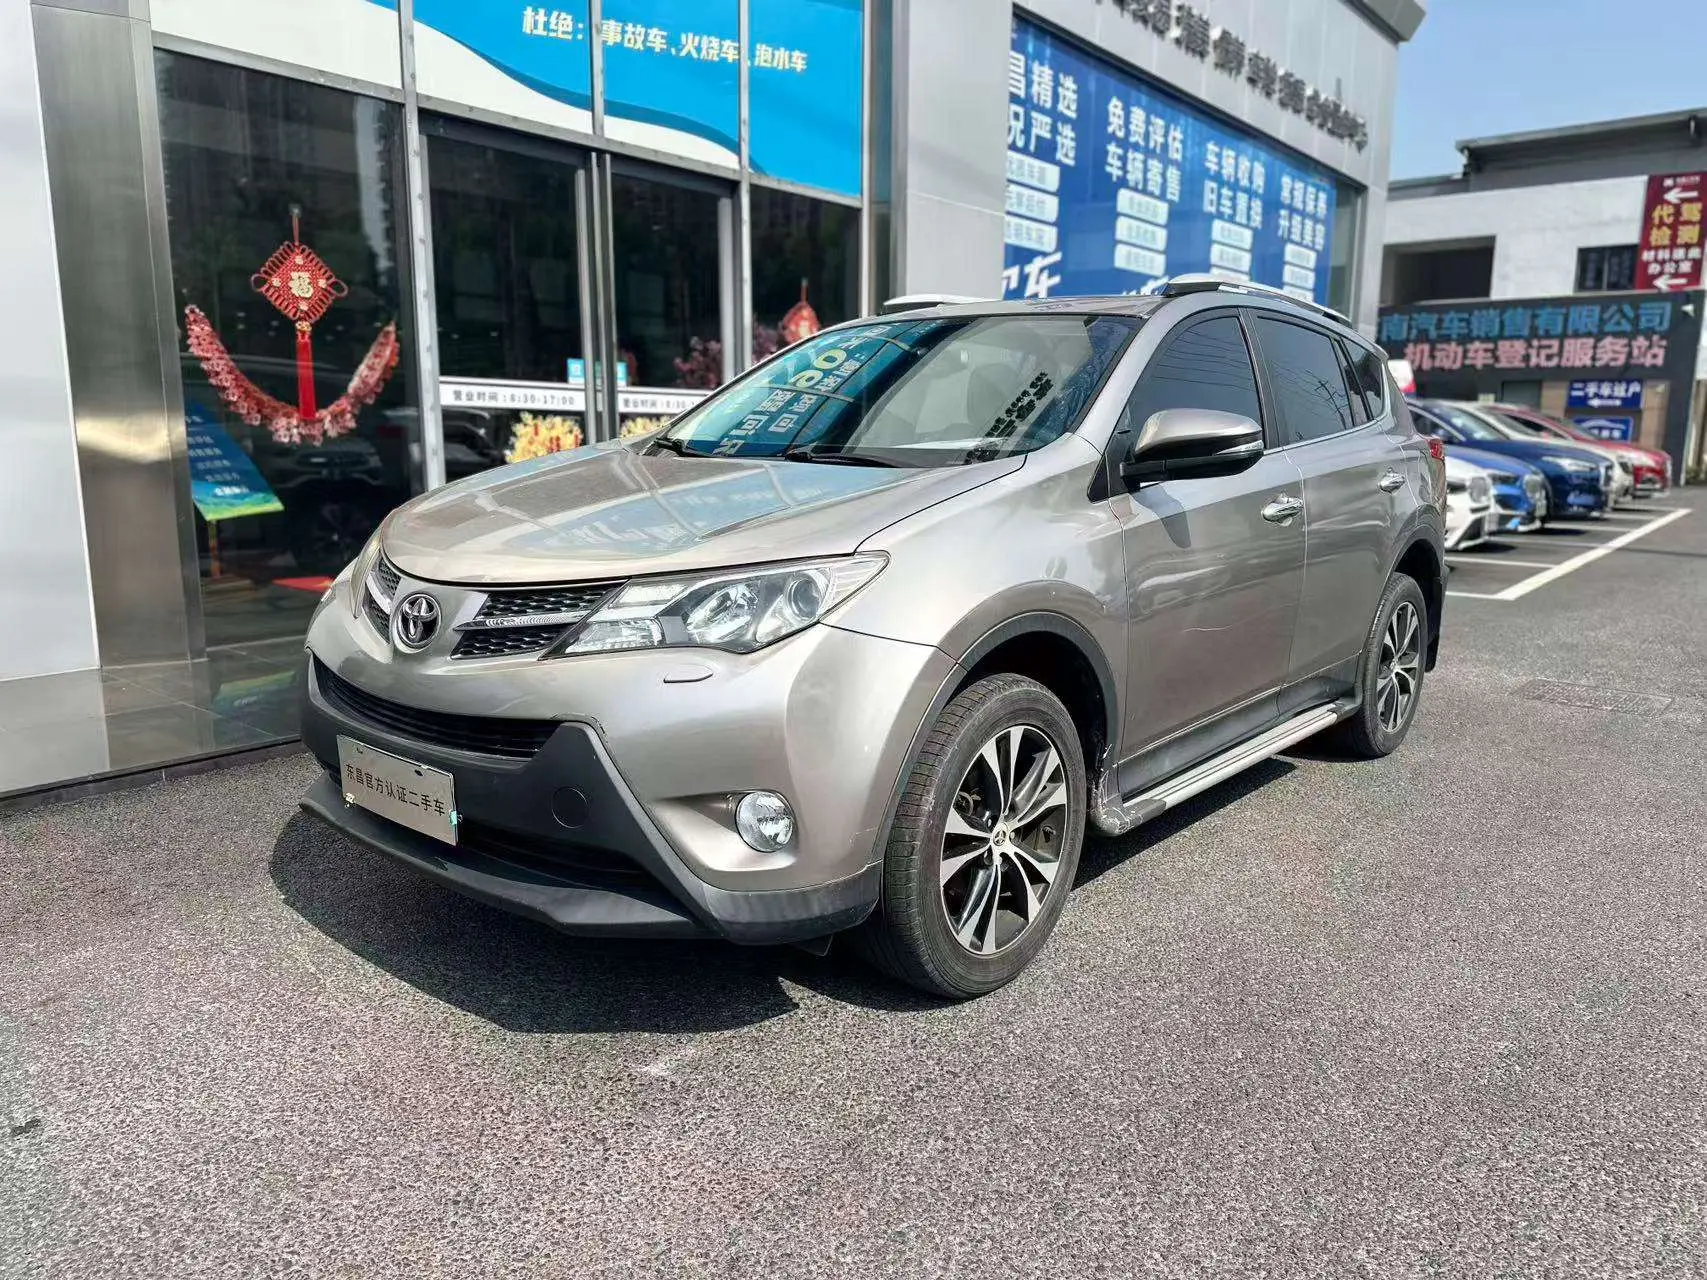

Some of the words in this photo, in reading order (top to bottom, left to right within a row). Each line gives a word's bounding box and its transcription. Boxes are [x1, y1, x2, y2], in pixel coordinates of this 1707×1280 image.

[1107, 96, 1184, 162] 免费评估
[1105, 142, 1181, 202] 车辆寄售
[1404, 335, 1668, 371] 机动车登记服务站
[1571, 381, 1641, 398] 二手车过户
[344, 763, 446, 817] 东昌官方认证二手车
